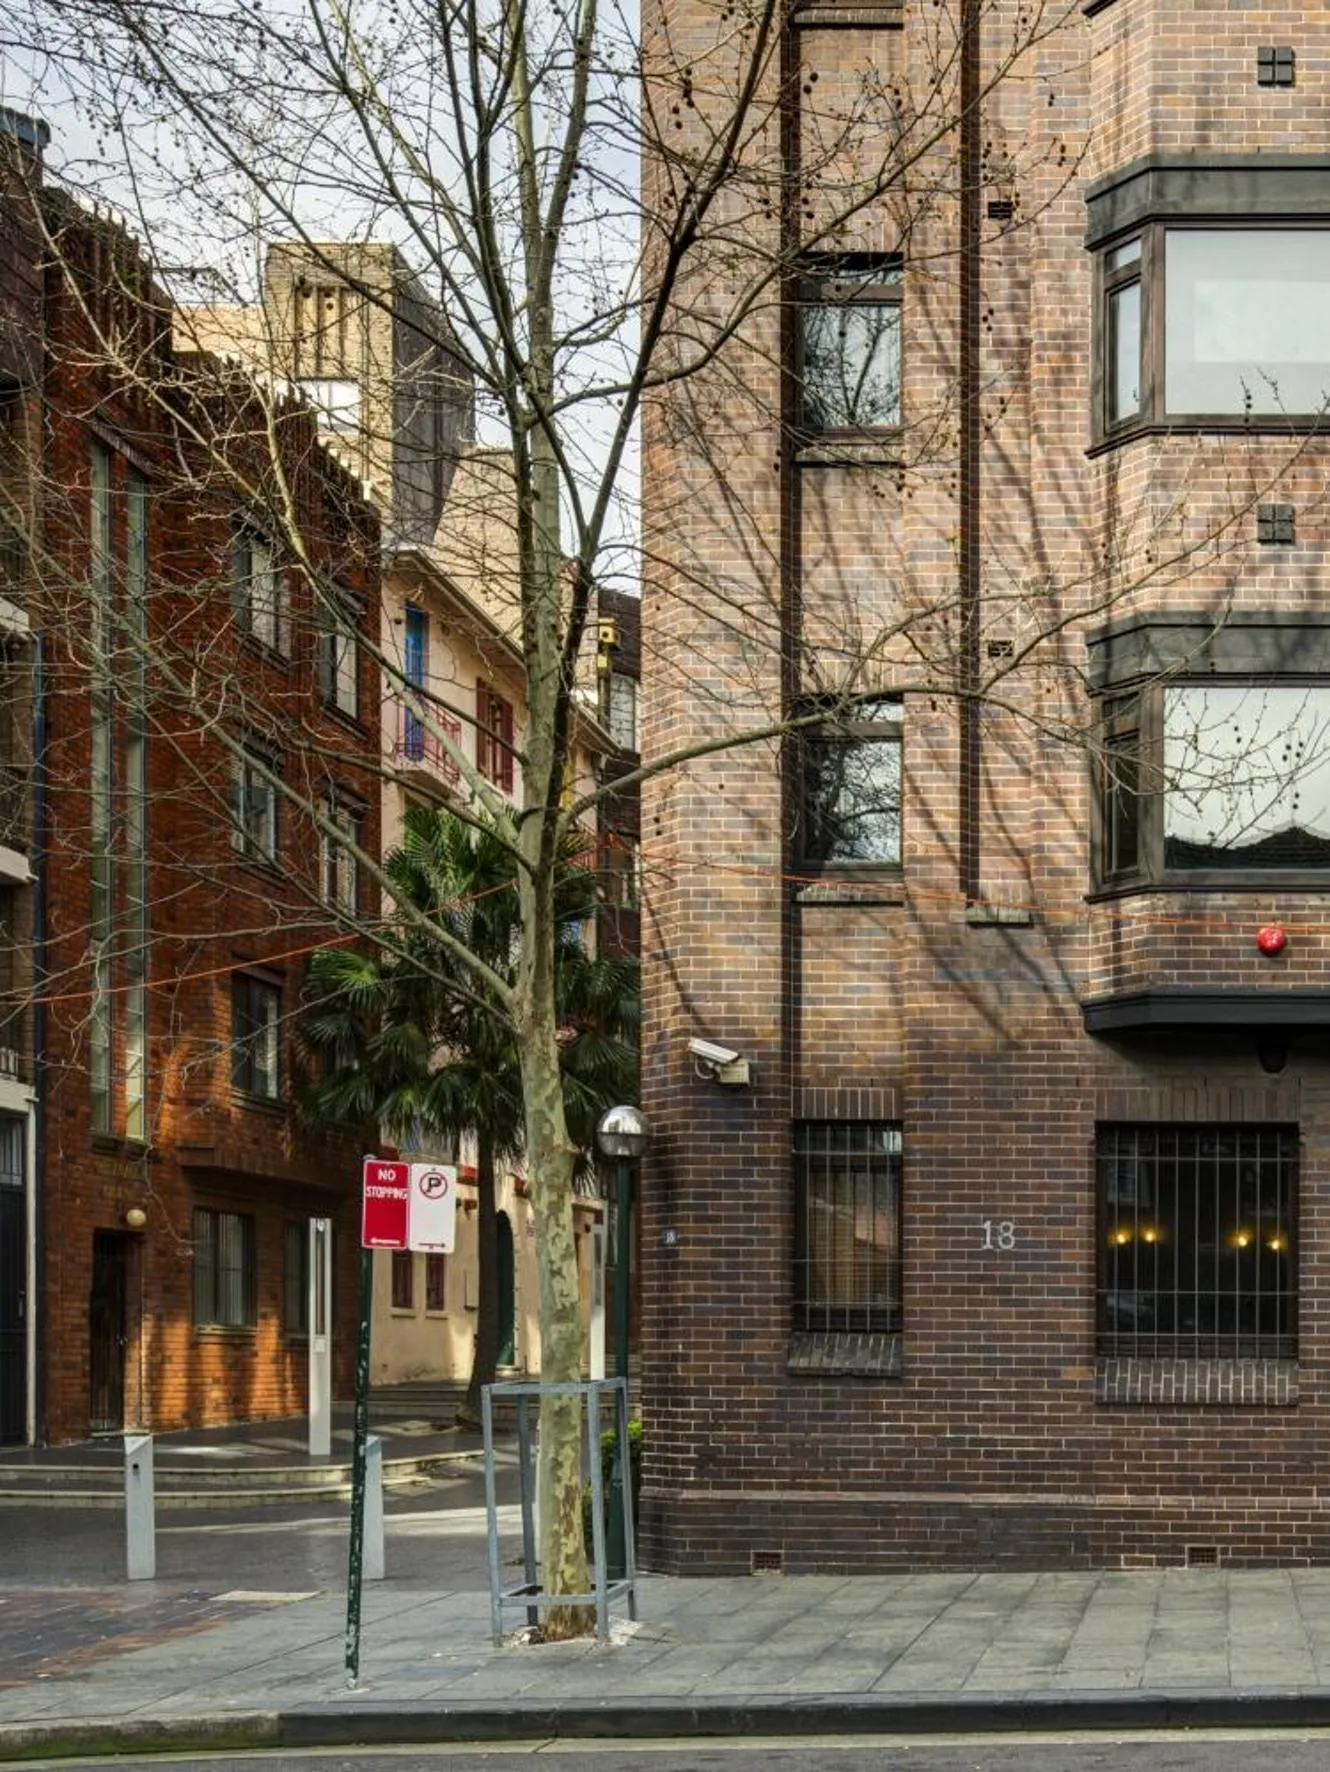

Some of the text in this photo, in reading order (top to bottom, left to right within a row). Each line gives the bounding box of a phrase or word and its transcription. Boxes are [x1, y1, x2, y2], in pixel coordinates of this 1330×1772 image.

[377, 1168, 397, 1181] NO
[366, 1186, 408, 1200] STOPPING
[983, 1220, 1016, 1250] 18
